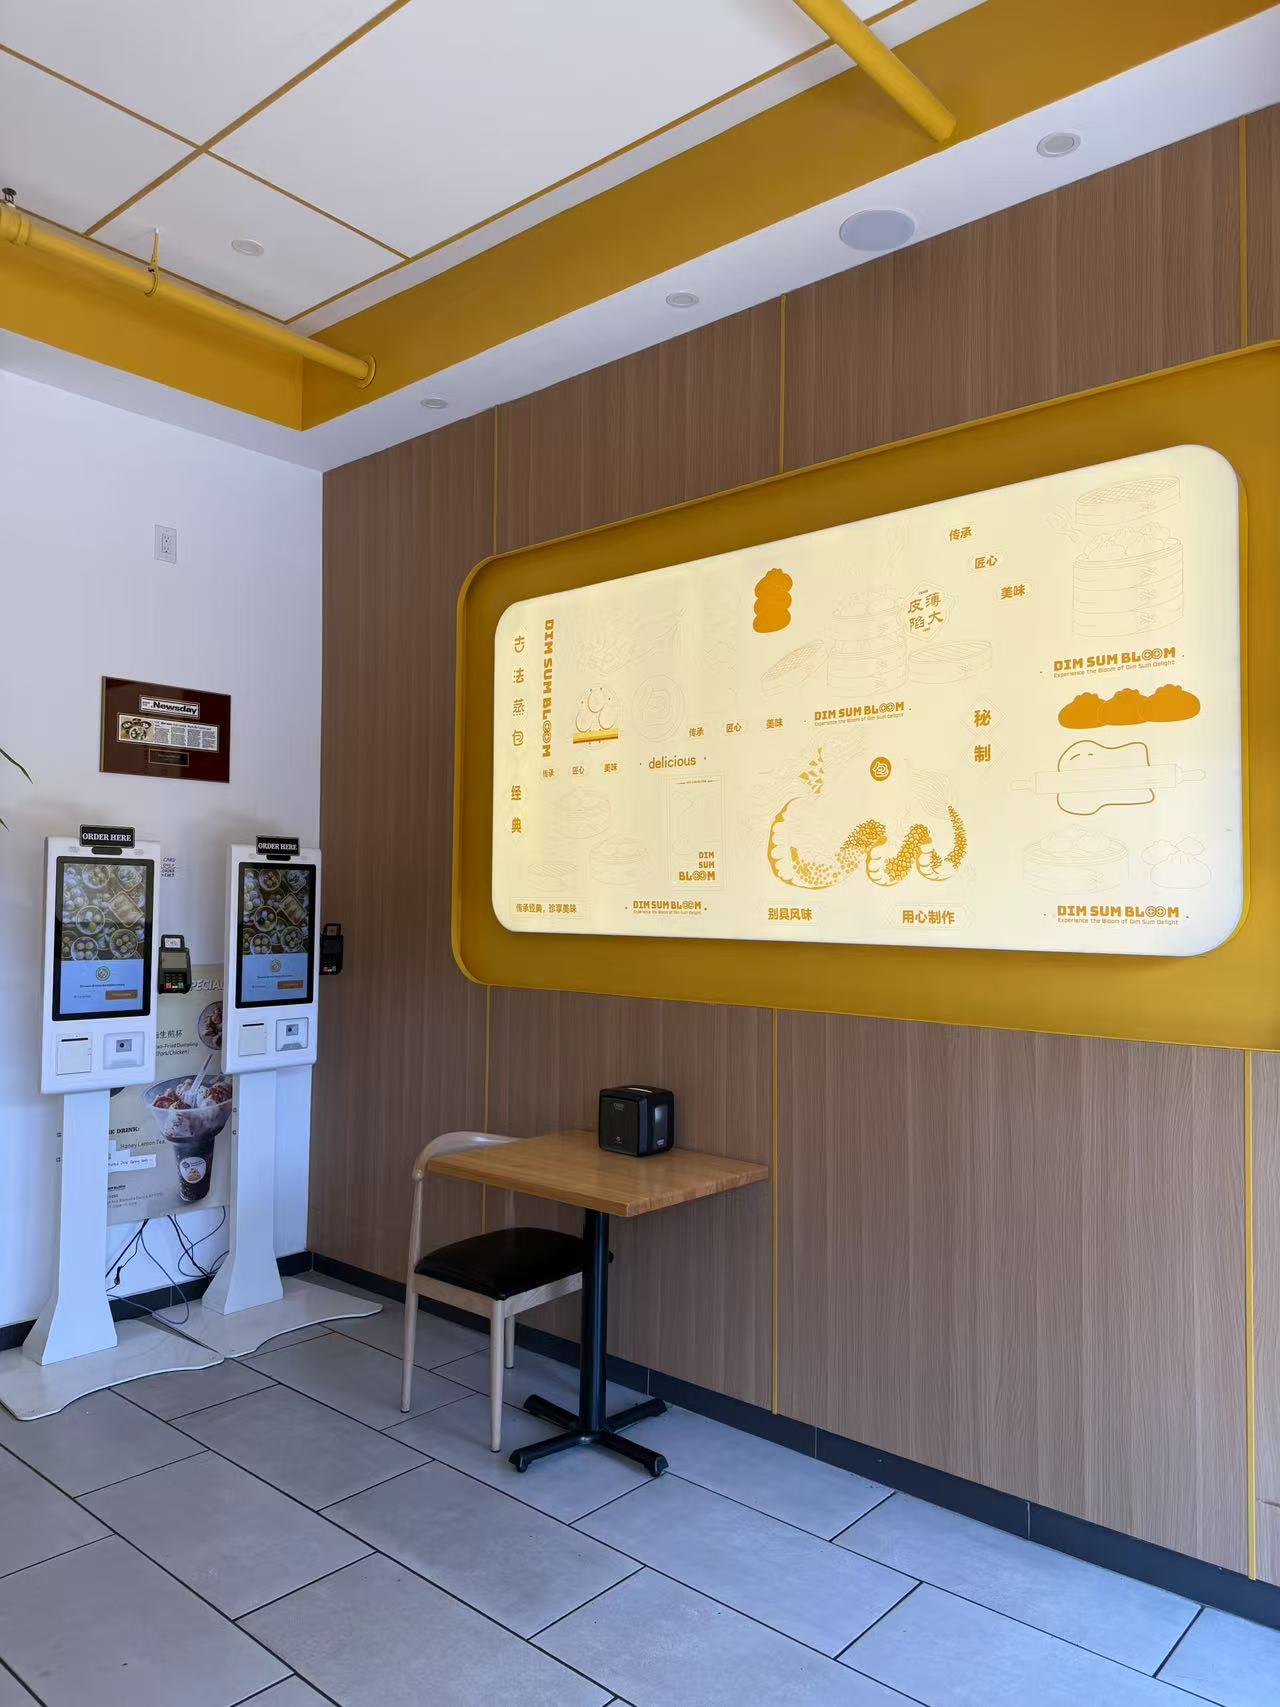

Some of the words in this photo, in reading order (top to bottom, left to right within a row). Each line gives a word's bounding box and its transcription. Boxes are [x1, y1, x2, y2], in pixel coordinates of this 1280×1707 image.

[948, 526, 972, 541] 传承
[975, 555, 998, 569] 匠心
[1001, 584, 1026, 599] 美味
[544, 619, 554, 655] DIM
[1053, 658, 1084, 672] DIM
[1086, 653, 1119, 668] SUM
[1121, 647, 1176, 663] BLOOM
[543, 658, 553, 695] SUM
[152, 701, 198, 715] Newsday
[814, 709, 837, 721] DIM
[838, 706, 862, 718] SUM
[864, 701, 905, 716] BLOOM
[542, 697, 552, 758] BLOOM
[688, 727, 704, 737] 传承
[726, 722, 742, 733] 匠心
[766, 718, 783, 729] 美味
[572, 765, 585, 775] 匠心
[603, 763, 618, 773] 美味
[648, 755, 697, 769] delicious
[511, 784, 522, 834] 经典
[82, 832, 110, 841] ORDER
[110, 834, 132, 842] HERE
[257, 842, 280, 850] ORDER
[698, 851, 715, 859] DIM
[678, 870, 716, 881] BLOOM
[633, 900, 650, 909] DIM
[651, 900, 670, 909] SUM
[671, 900, 702, 910] BLOOM
[1057, 905, 1087, 917] DIM
[1090, 905, 1122, 917] SUM
[1125, 905, 1180, 918] BLOOM
[768, 907, 813, 921] 别具风味
[902, 910, 955, 924] 用心制作
